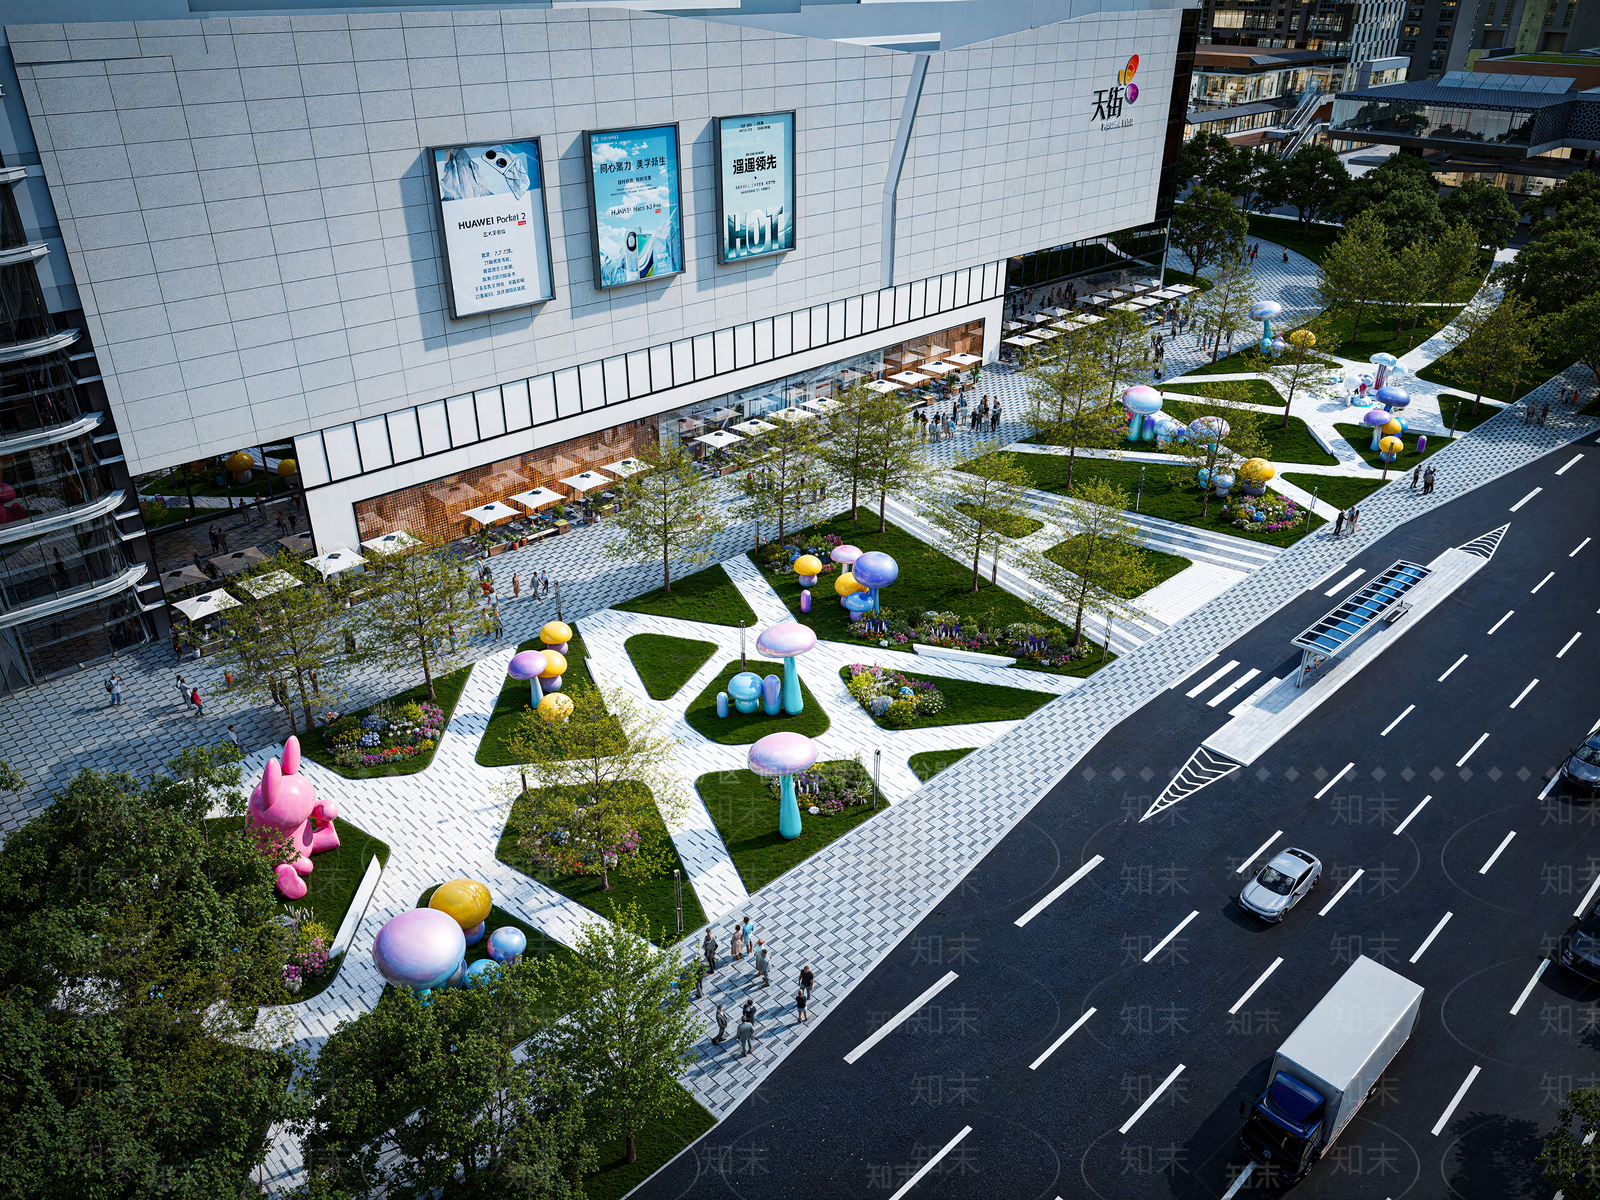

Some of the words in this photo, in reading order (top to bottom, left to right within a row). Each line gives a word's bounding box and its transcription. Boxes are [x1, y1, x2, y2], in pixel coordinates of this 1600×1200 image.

[1091, 86, 1125, 122] 天街
[732, 154, 777, 175] 遥遥领先
[458, 216, 494, 230] HUAWEI
[520, 212, 526, 220] 2
[728, 205, 784, 259] HOT
